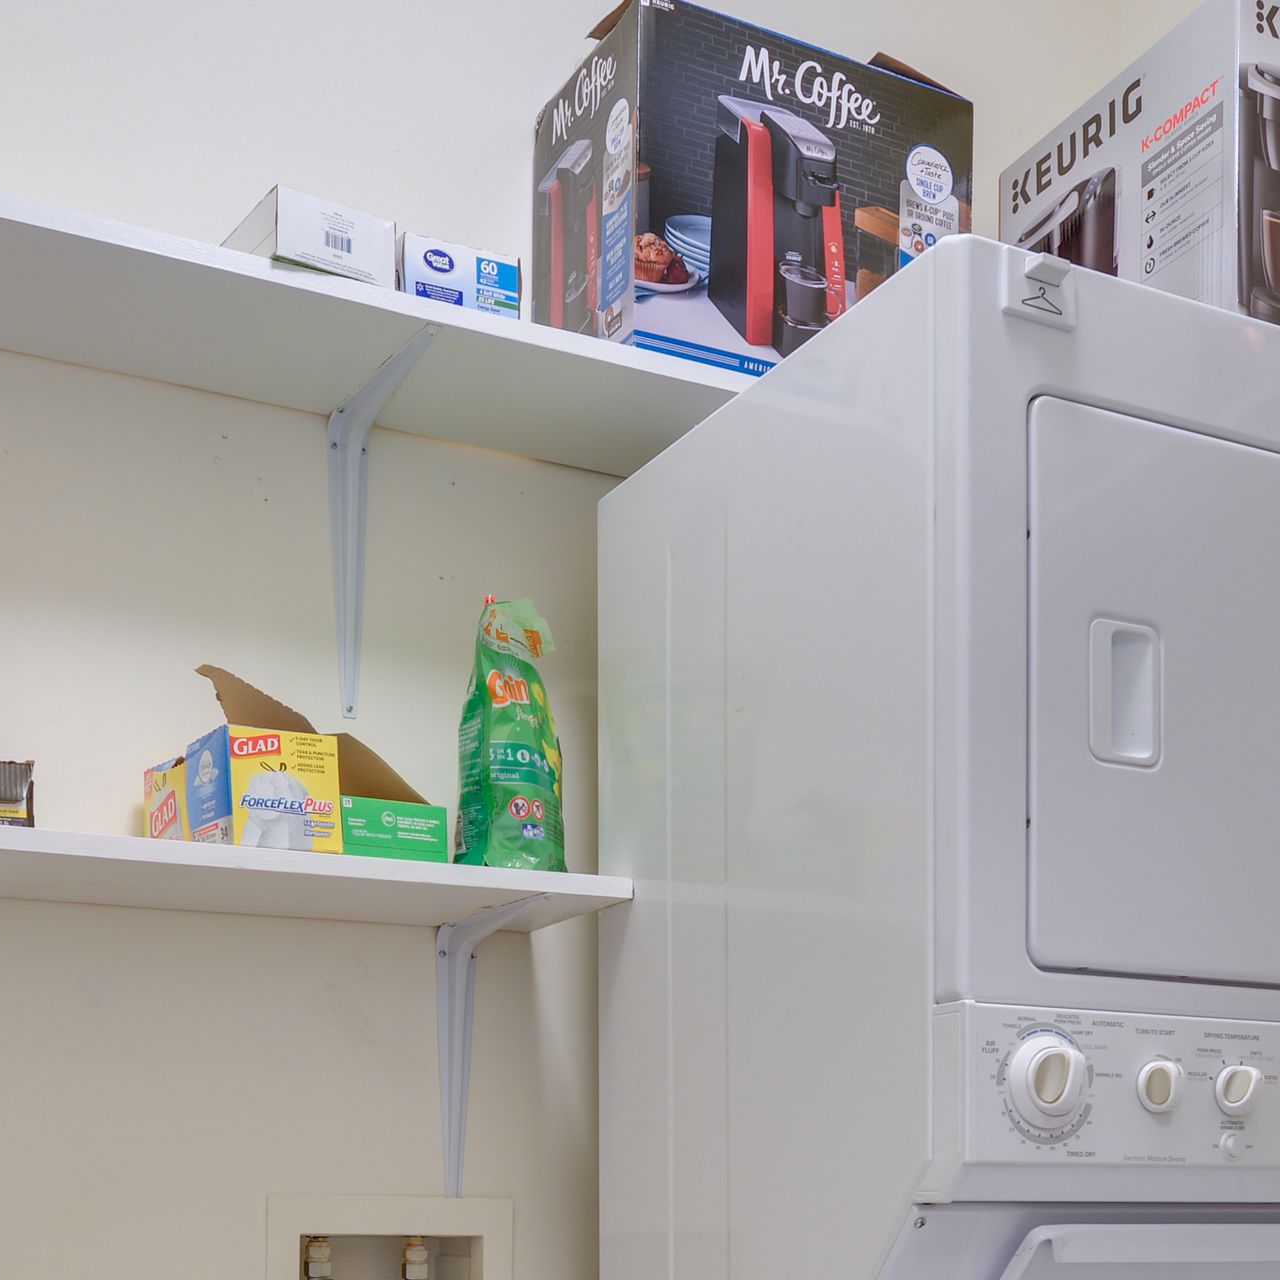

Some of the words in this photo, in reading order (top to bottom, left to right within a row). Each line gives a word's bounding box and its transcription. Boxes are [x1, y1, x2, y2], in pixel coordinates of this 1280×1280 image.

[739, 44, 790, 100] Mr.
[795, 60, 881, 129] Coffee
[552, 98, 574, 145] Mr.
[575, 54, 617, 119] Coffee
[1141, 79, 1220, 153] K-COMPACT
[1012, 77, 1145, 214] KEURIG
[1147, 150, 1170, 172] Slender
[1176, 130, 1195, 149] Space
[1195, 113, 1217, 134] Saving
[915, 178, 933, 191] SINGLE
[933, 182, 944, 193] CUP
[922, 189, 936, 200] BREW
[905, 199, 923, 211] BREWS
[913, 210, 934, 225] GROUND
[934, 217, 952, 231] COFFEE
[426, 251, 450, 267] Great
[432, 260, 452, 272] Value
[480, 261, 498, 275] 60
[487, 669, 530, 706] Gain
[233, 738, 278, 755] GLAD
[152, 799, 175, 836] GLAD
[1092, 1020, 1124, 1028] AUTOMATIC
[1225, 1033, 1260, 1041] TEMPERATURE
